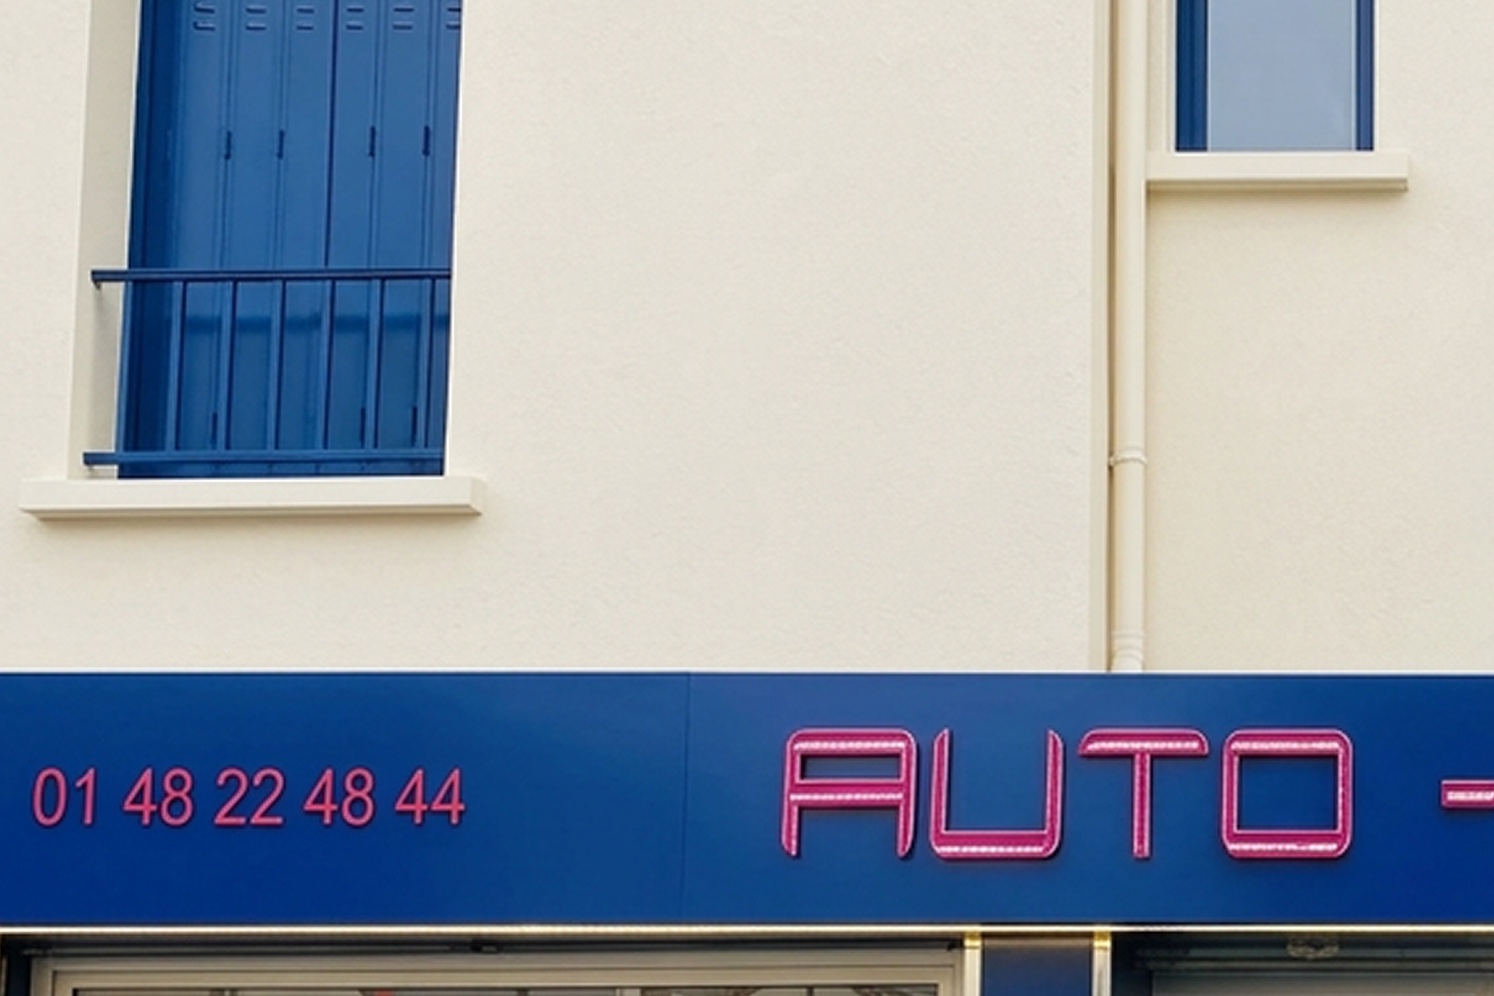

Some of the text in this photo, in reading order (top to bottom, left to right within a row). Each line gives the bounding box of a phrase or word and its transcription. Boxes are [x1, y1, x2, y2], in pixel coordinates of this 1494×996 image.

[32, 768, 465, 826] 01 48 22 48 44
[781, 729, 1353, 859] AUTO
